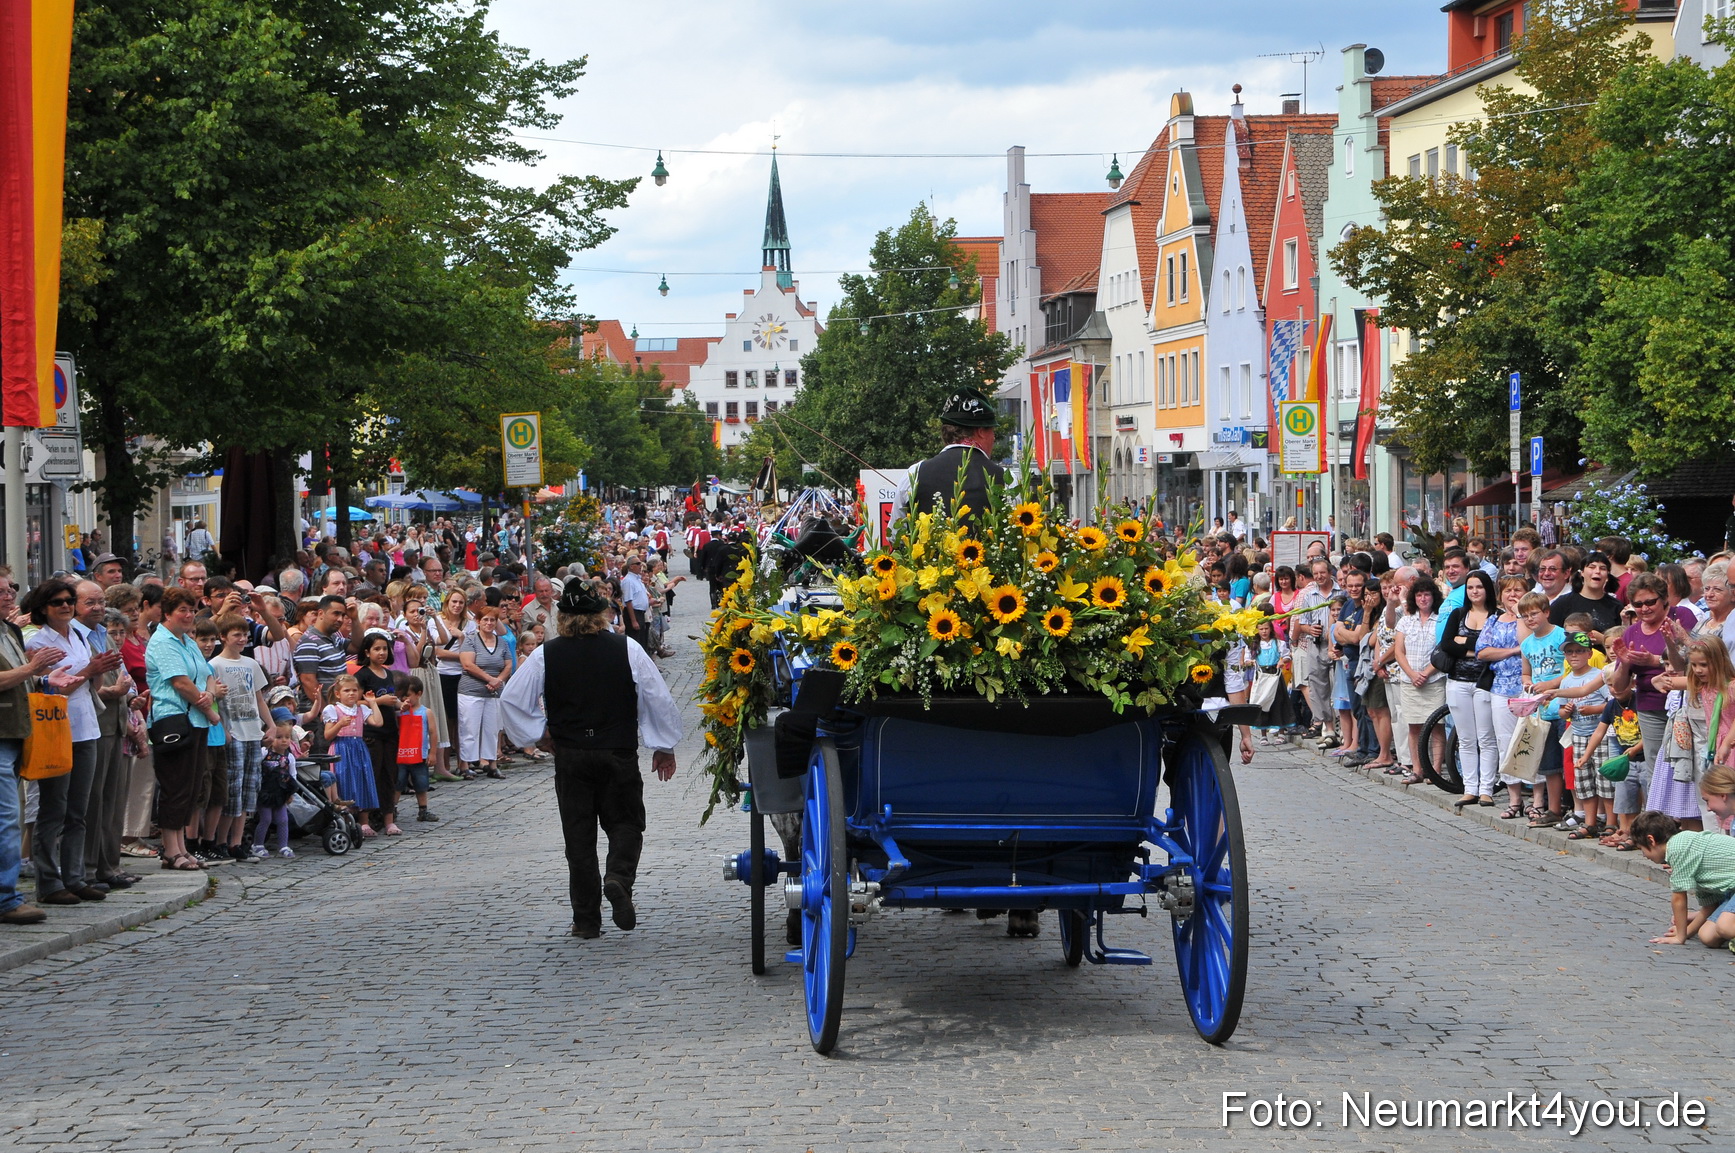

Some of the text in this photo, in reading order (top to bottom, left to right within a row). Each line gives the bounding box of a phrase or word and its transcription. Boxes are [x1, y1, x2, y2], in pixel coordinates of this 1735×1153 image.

[1511, 378, 1518, 406] P
[57, 412, 68, 424] NE
[1293, 412, 1307, 429] H
[514, 425, 528, 442] H
[1533, 442, 1540, 471] P
[879, 488, 896, 500] Sta
[398, 747, 419, 756] SPRIT
